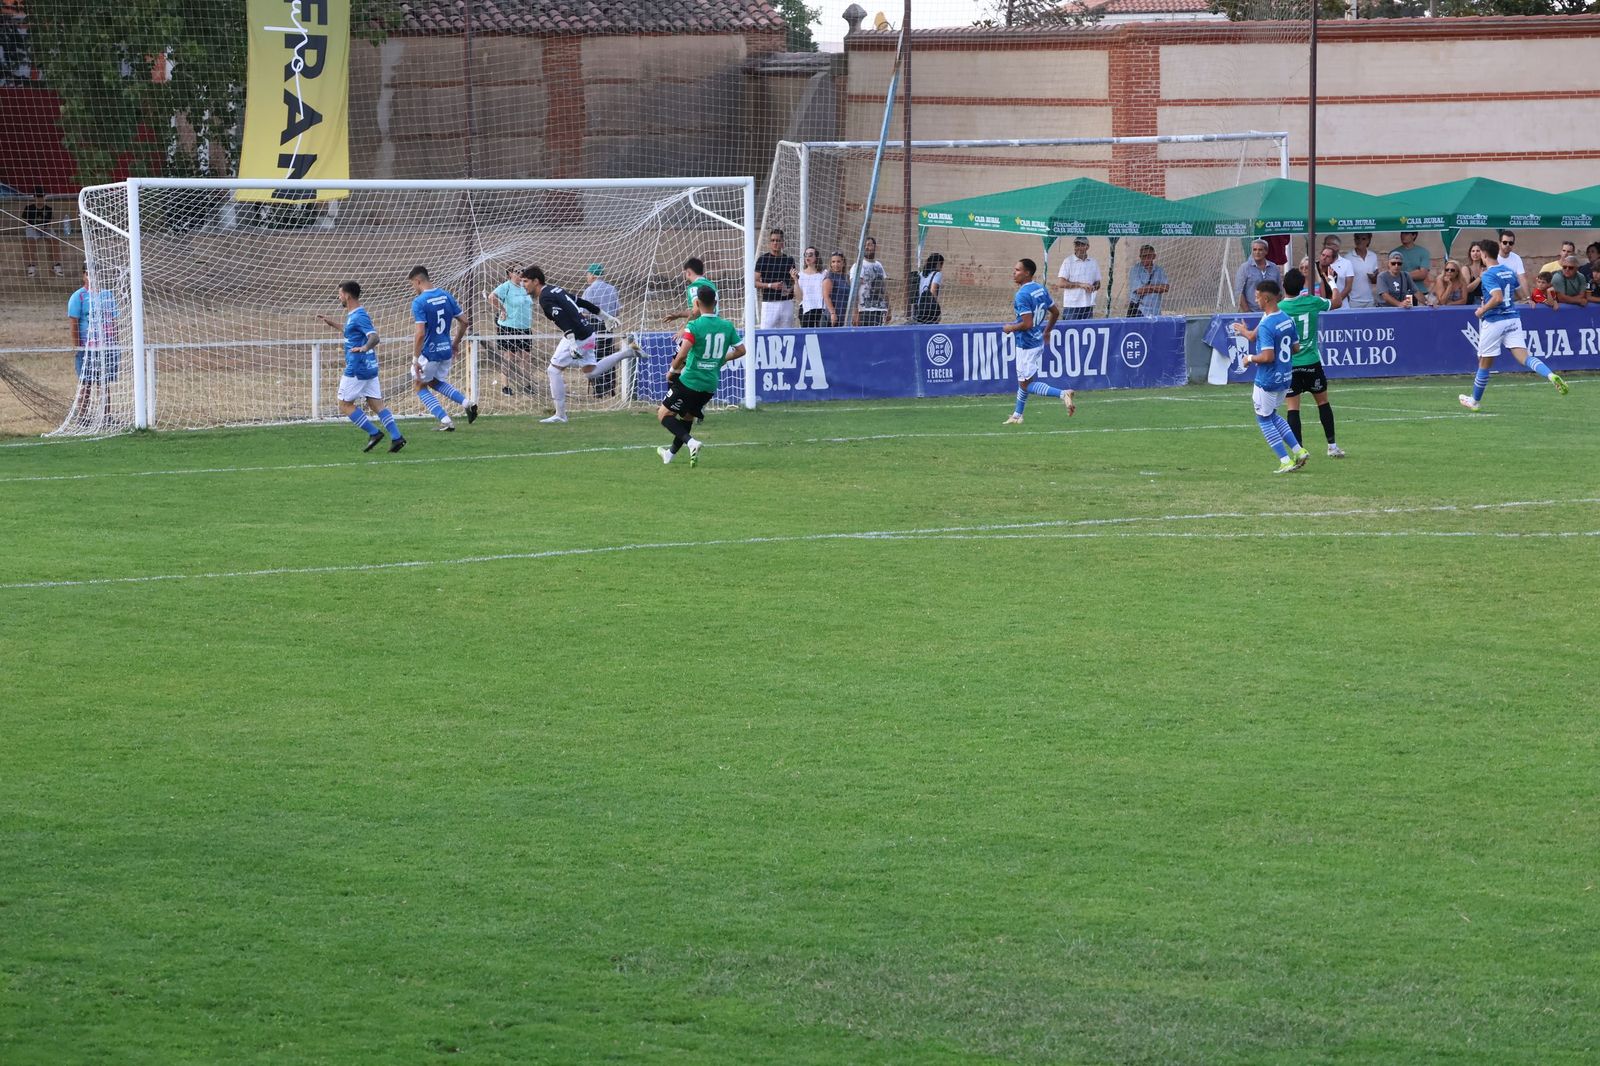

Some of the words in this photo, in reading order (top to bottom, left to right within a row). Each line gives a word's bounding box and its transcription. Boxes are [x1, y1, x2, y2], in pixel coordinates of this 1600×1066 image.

[1503, 283, 1511, 307] 4
[436, 309, 446, 335] 5
[702, 333, 725, 359] 10
[1317, 329, 1373, 343] MIENTO
[1376, 328, 1395, 341] DE
[1521, 329, 1574, 358] AJA
[1279, 335, 1291, 363] 8
[1317, 346, 1397, 367] ARALBO
[763, 371, 791, 391] S.L.
[927, 368, 953, 379] TERCERA
